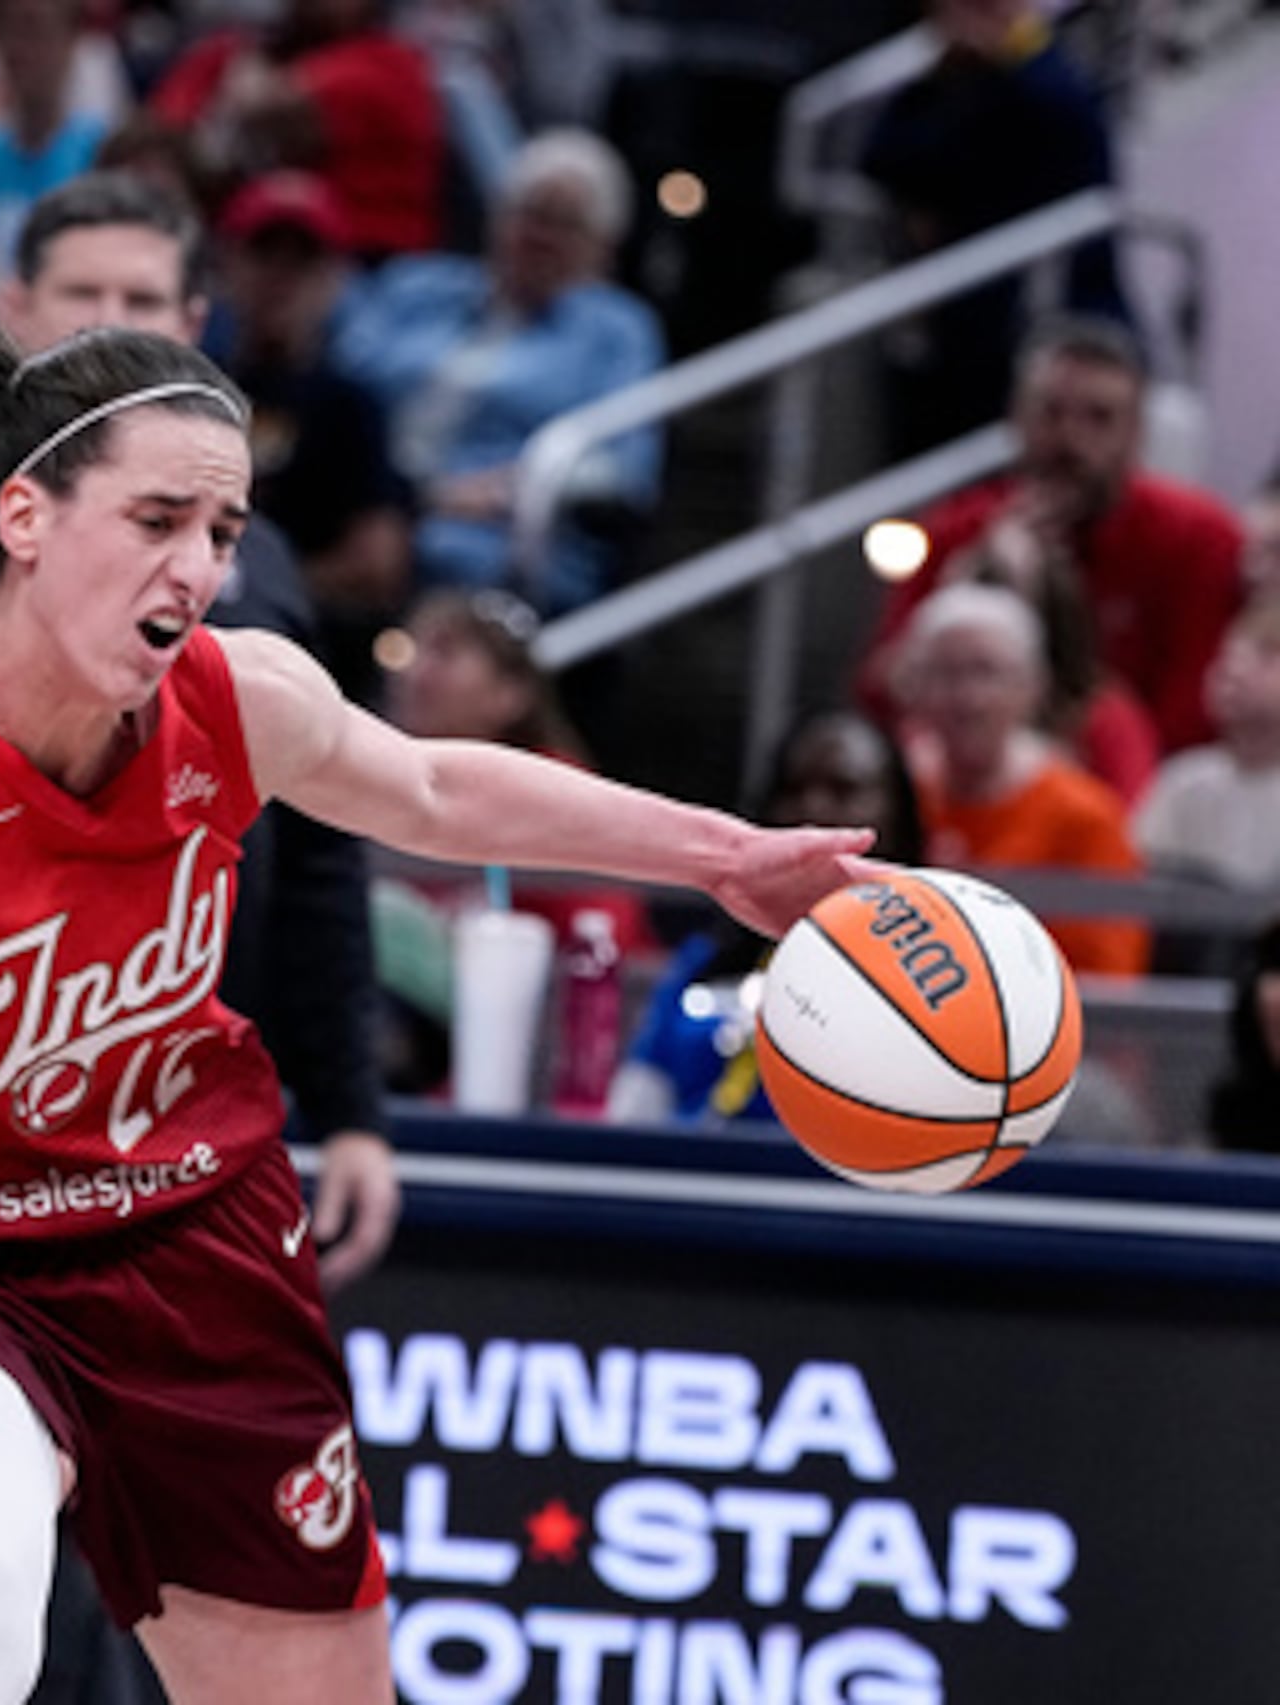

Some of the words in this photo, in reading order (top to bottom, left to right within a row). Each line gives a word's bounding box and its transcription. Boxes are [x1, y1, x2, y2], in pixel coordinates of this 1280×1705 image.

[345, 1328, 896, 1481] WNBA
[589, 1477, 1077, 1629] STAR
[386, 1597, 943, 1705] OTING
